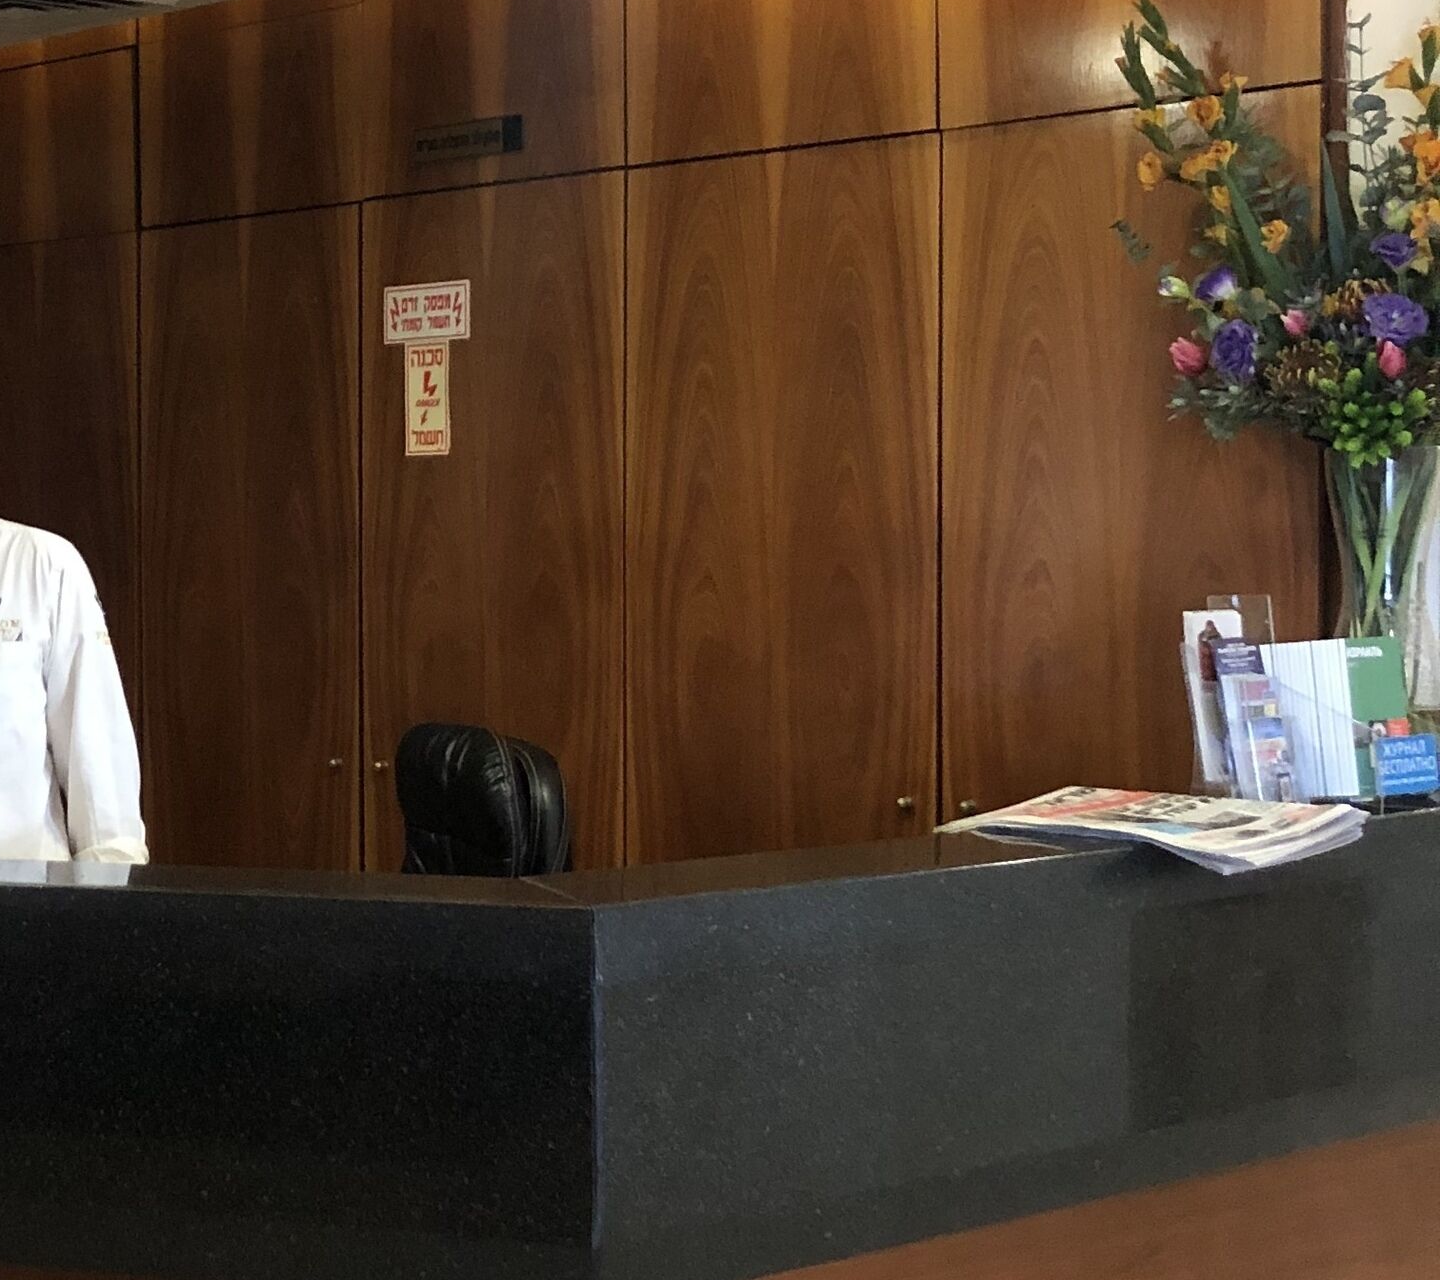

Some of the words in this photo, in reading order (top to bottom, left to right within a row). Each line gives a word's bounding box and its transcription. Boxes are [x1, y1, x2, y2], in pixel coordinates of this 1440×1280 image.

[410, 349, 443, 368] סכנה
[411, 429, 444, 446] חשמל
[1382, 738, 1426, 757] ЖУРНАЛ
